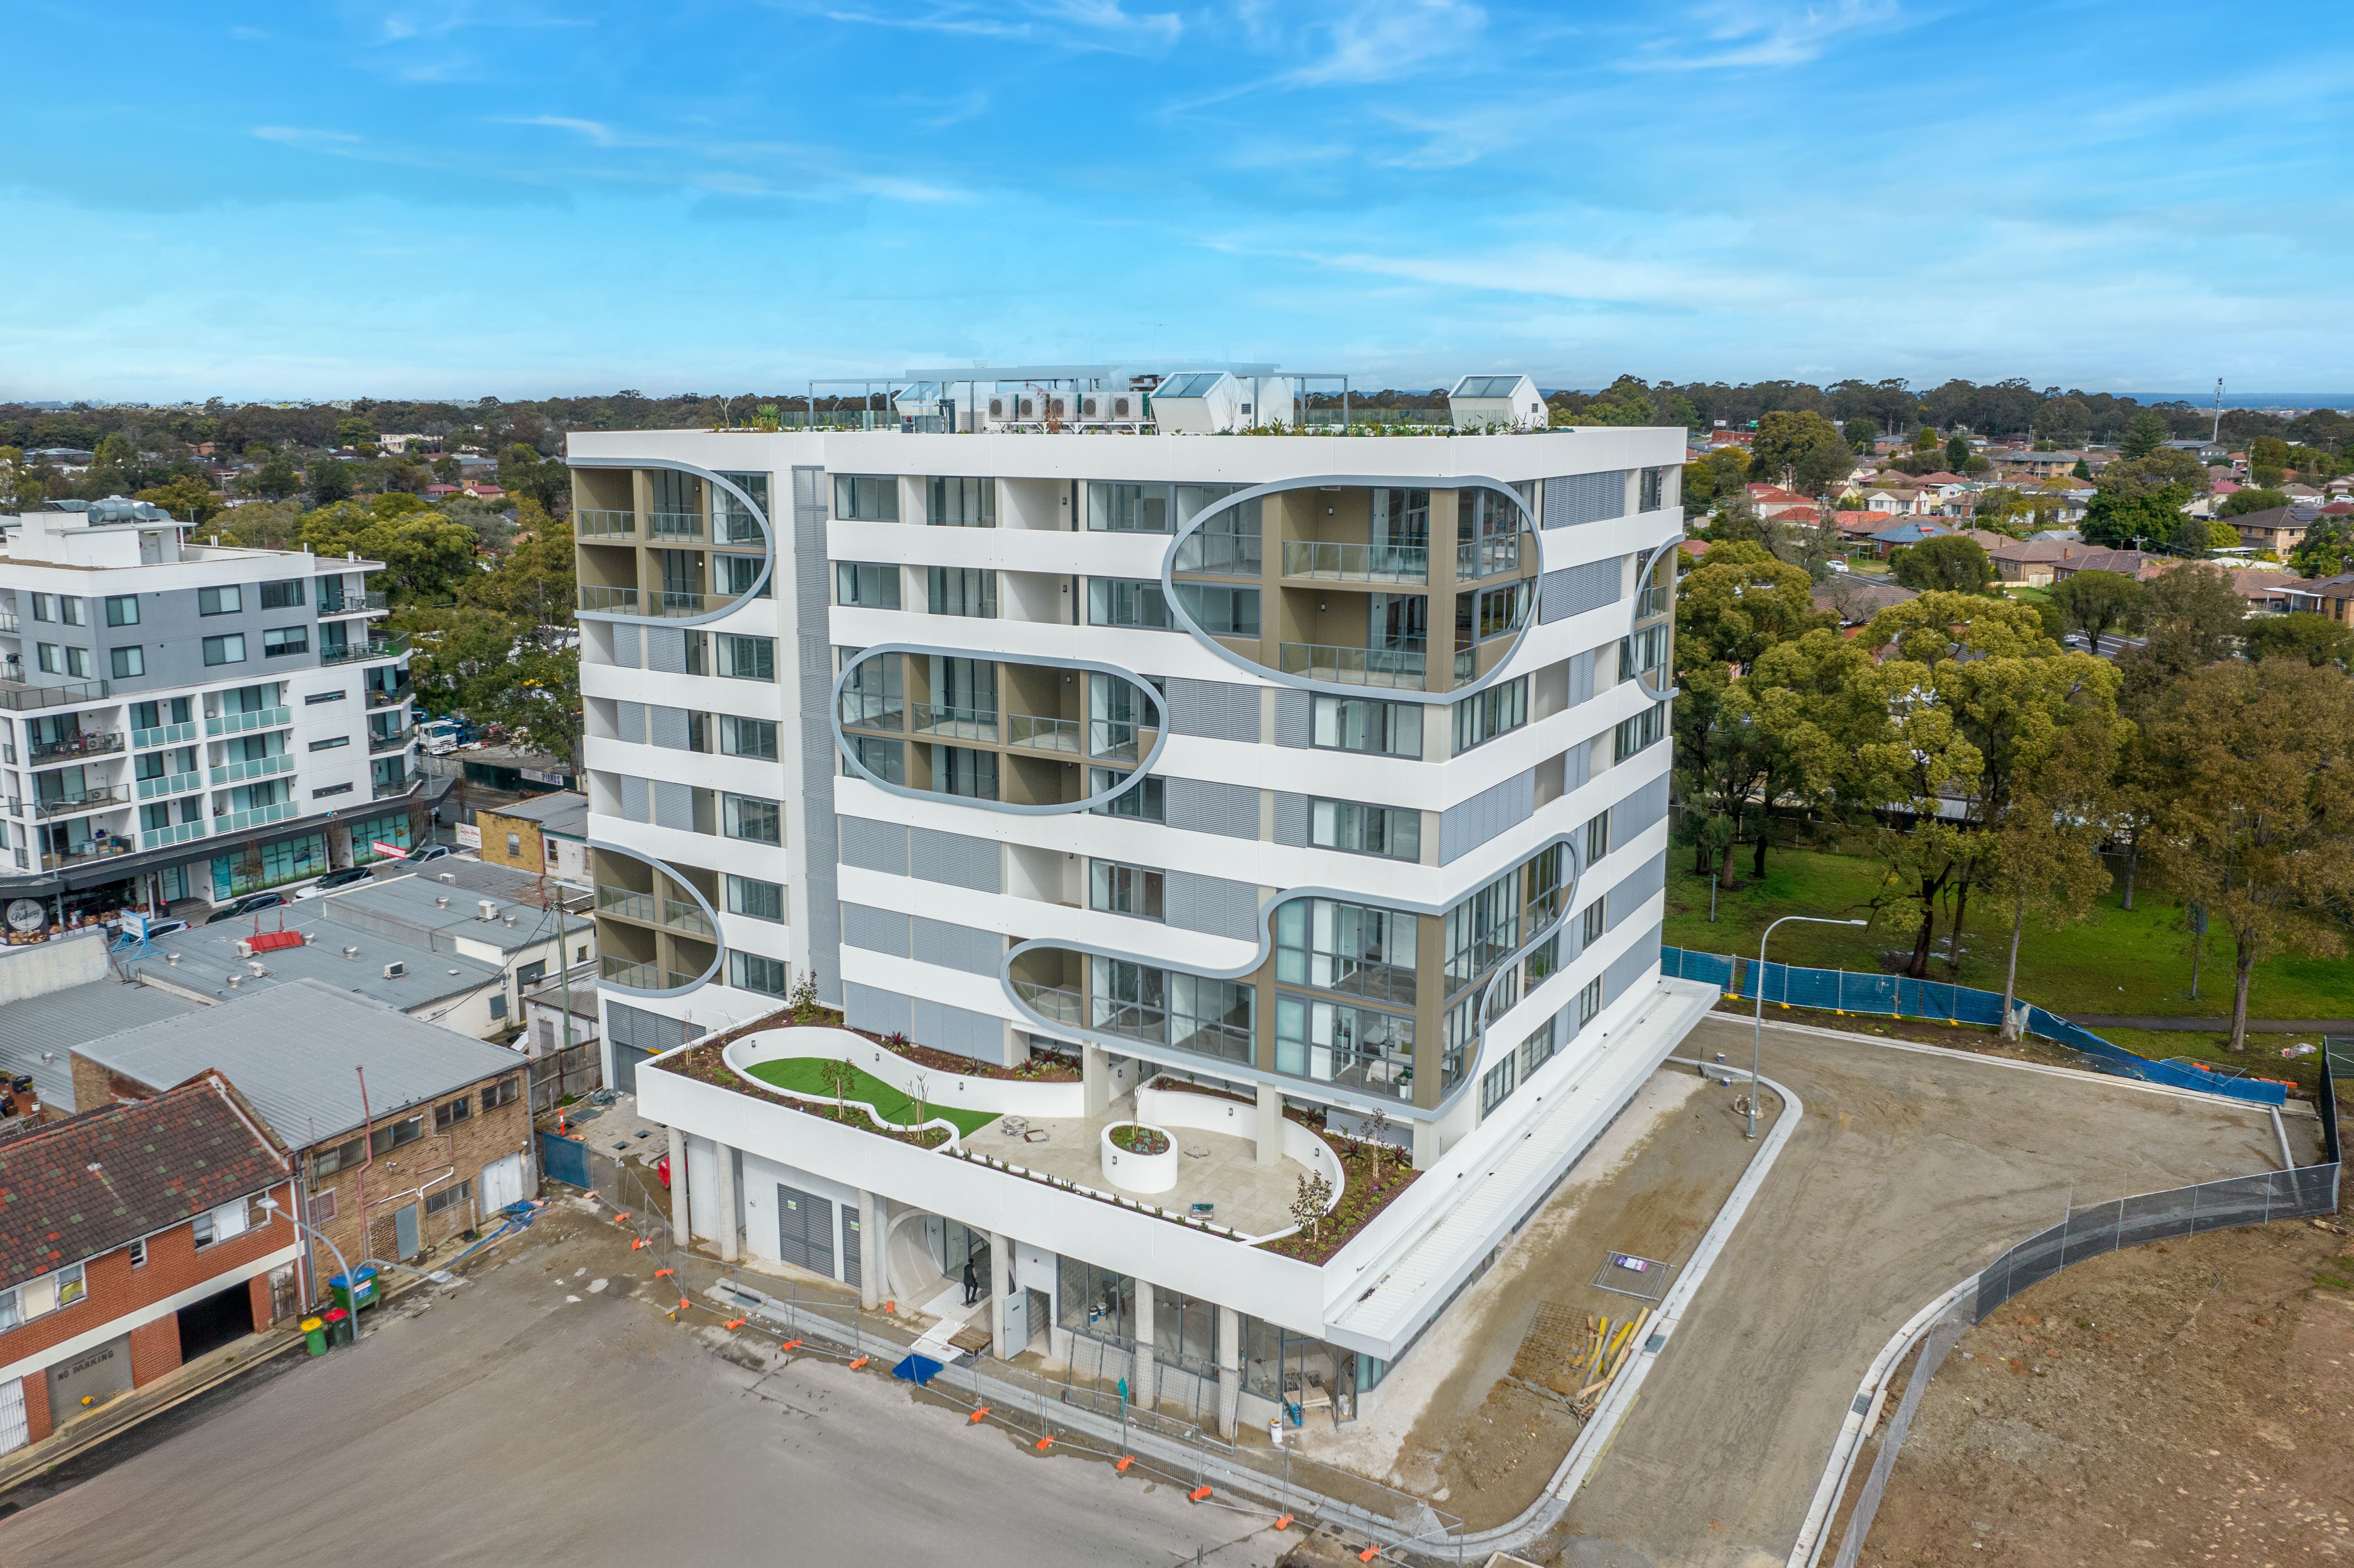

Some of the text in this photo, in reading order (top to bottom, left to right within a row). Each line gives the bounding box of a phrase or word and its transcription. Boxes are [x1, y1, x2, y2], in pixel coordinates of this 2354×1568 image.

[11, 908, 40, 924] Bakery
[58, 1370, 69, 1381] NO
[73, 1350, 114, 1374] PARKING
